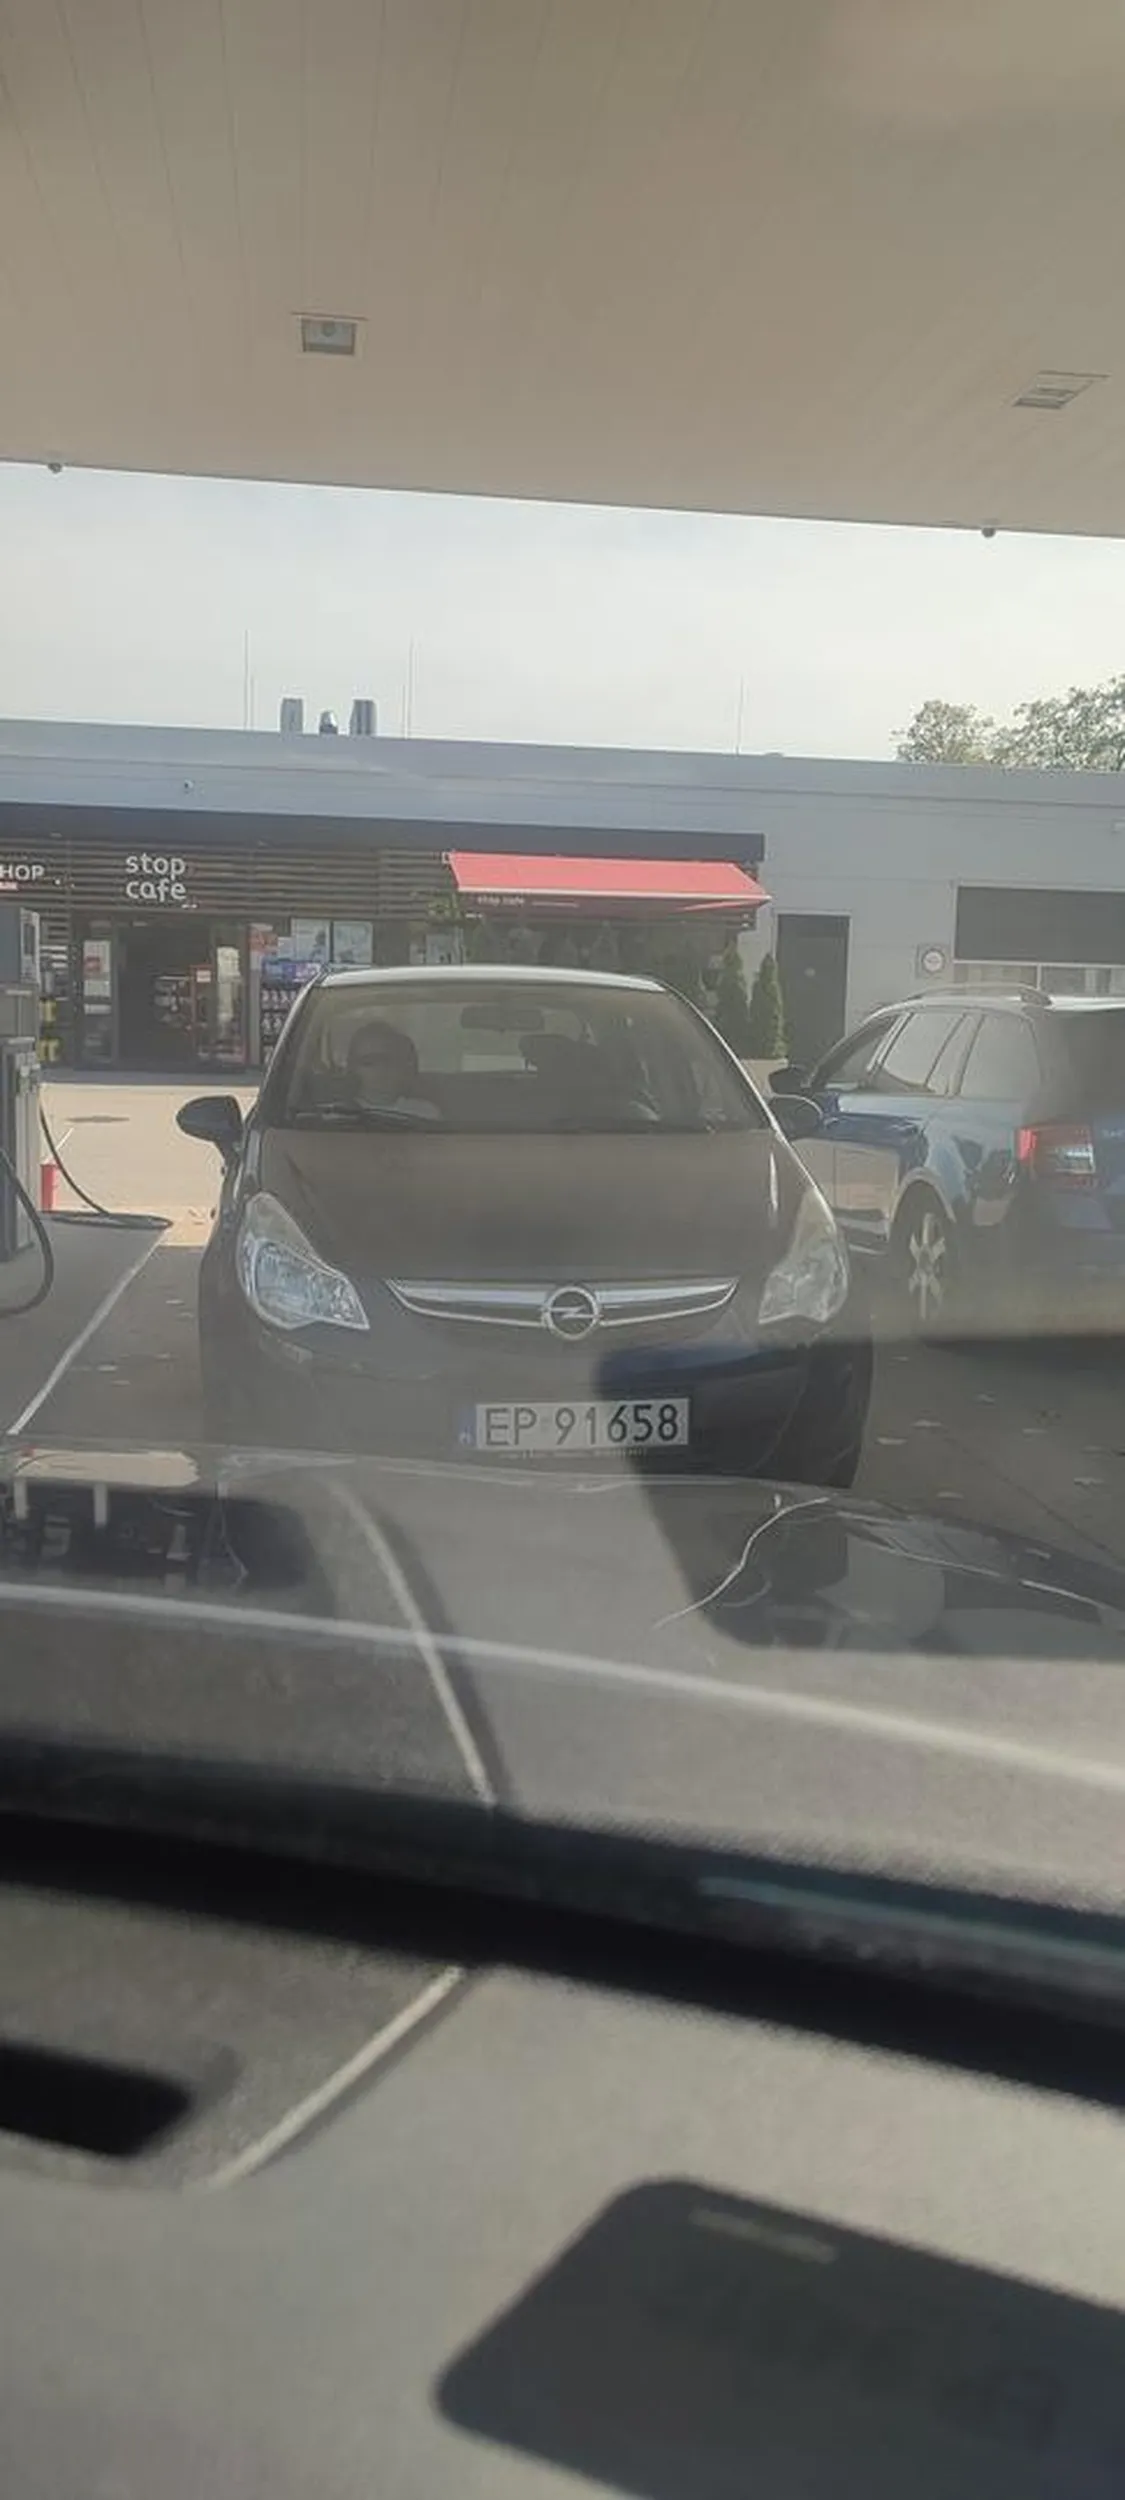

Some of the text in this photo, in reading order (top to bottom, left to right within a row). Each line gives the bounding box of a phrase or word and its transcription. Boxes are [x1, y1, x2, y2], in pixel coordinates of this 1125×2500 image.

[125, 852, 186, 881] stop
[125, 878, 187, 902] cafe
[485, 1403, 679, 1446] EP 91658
